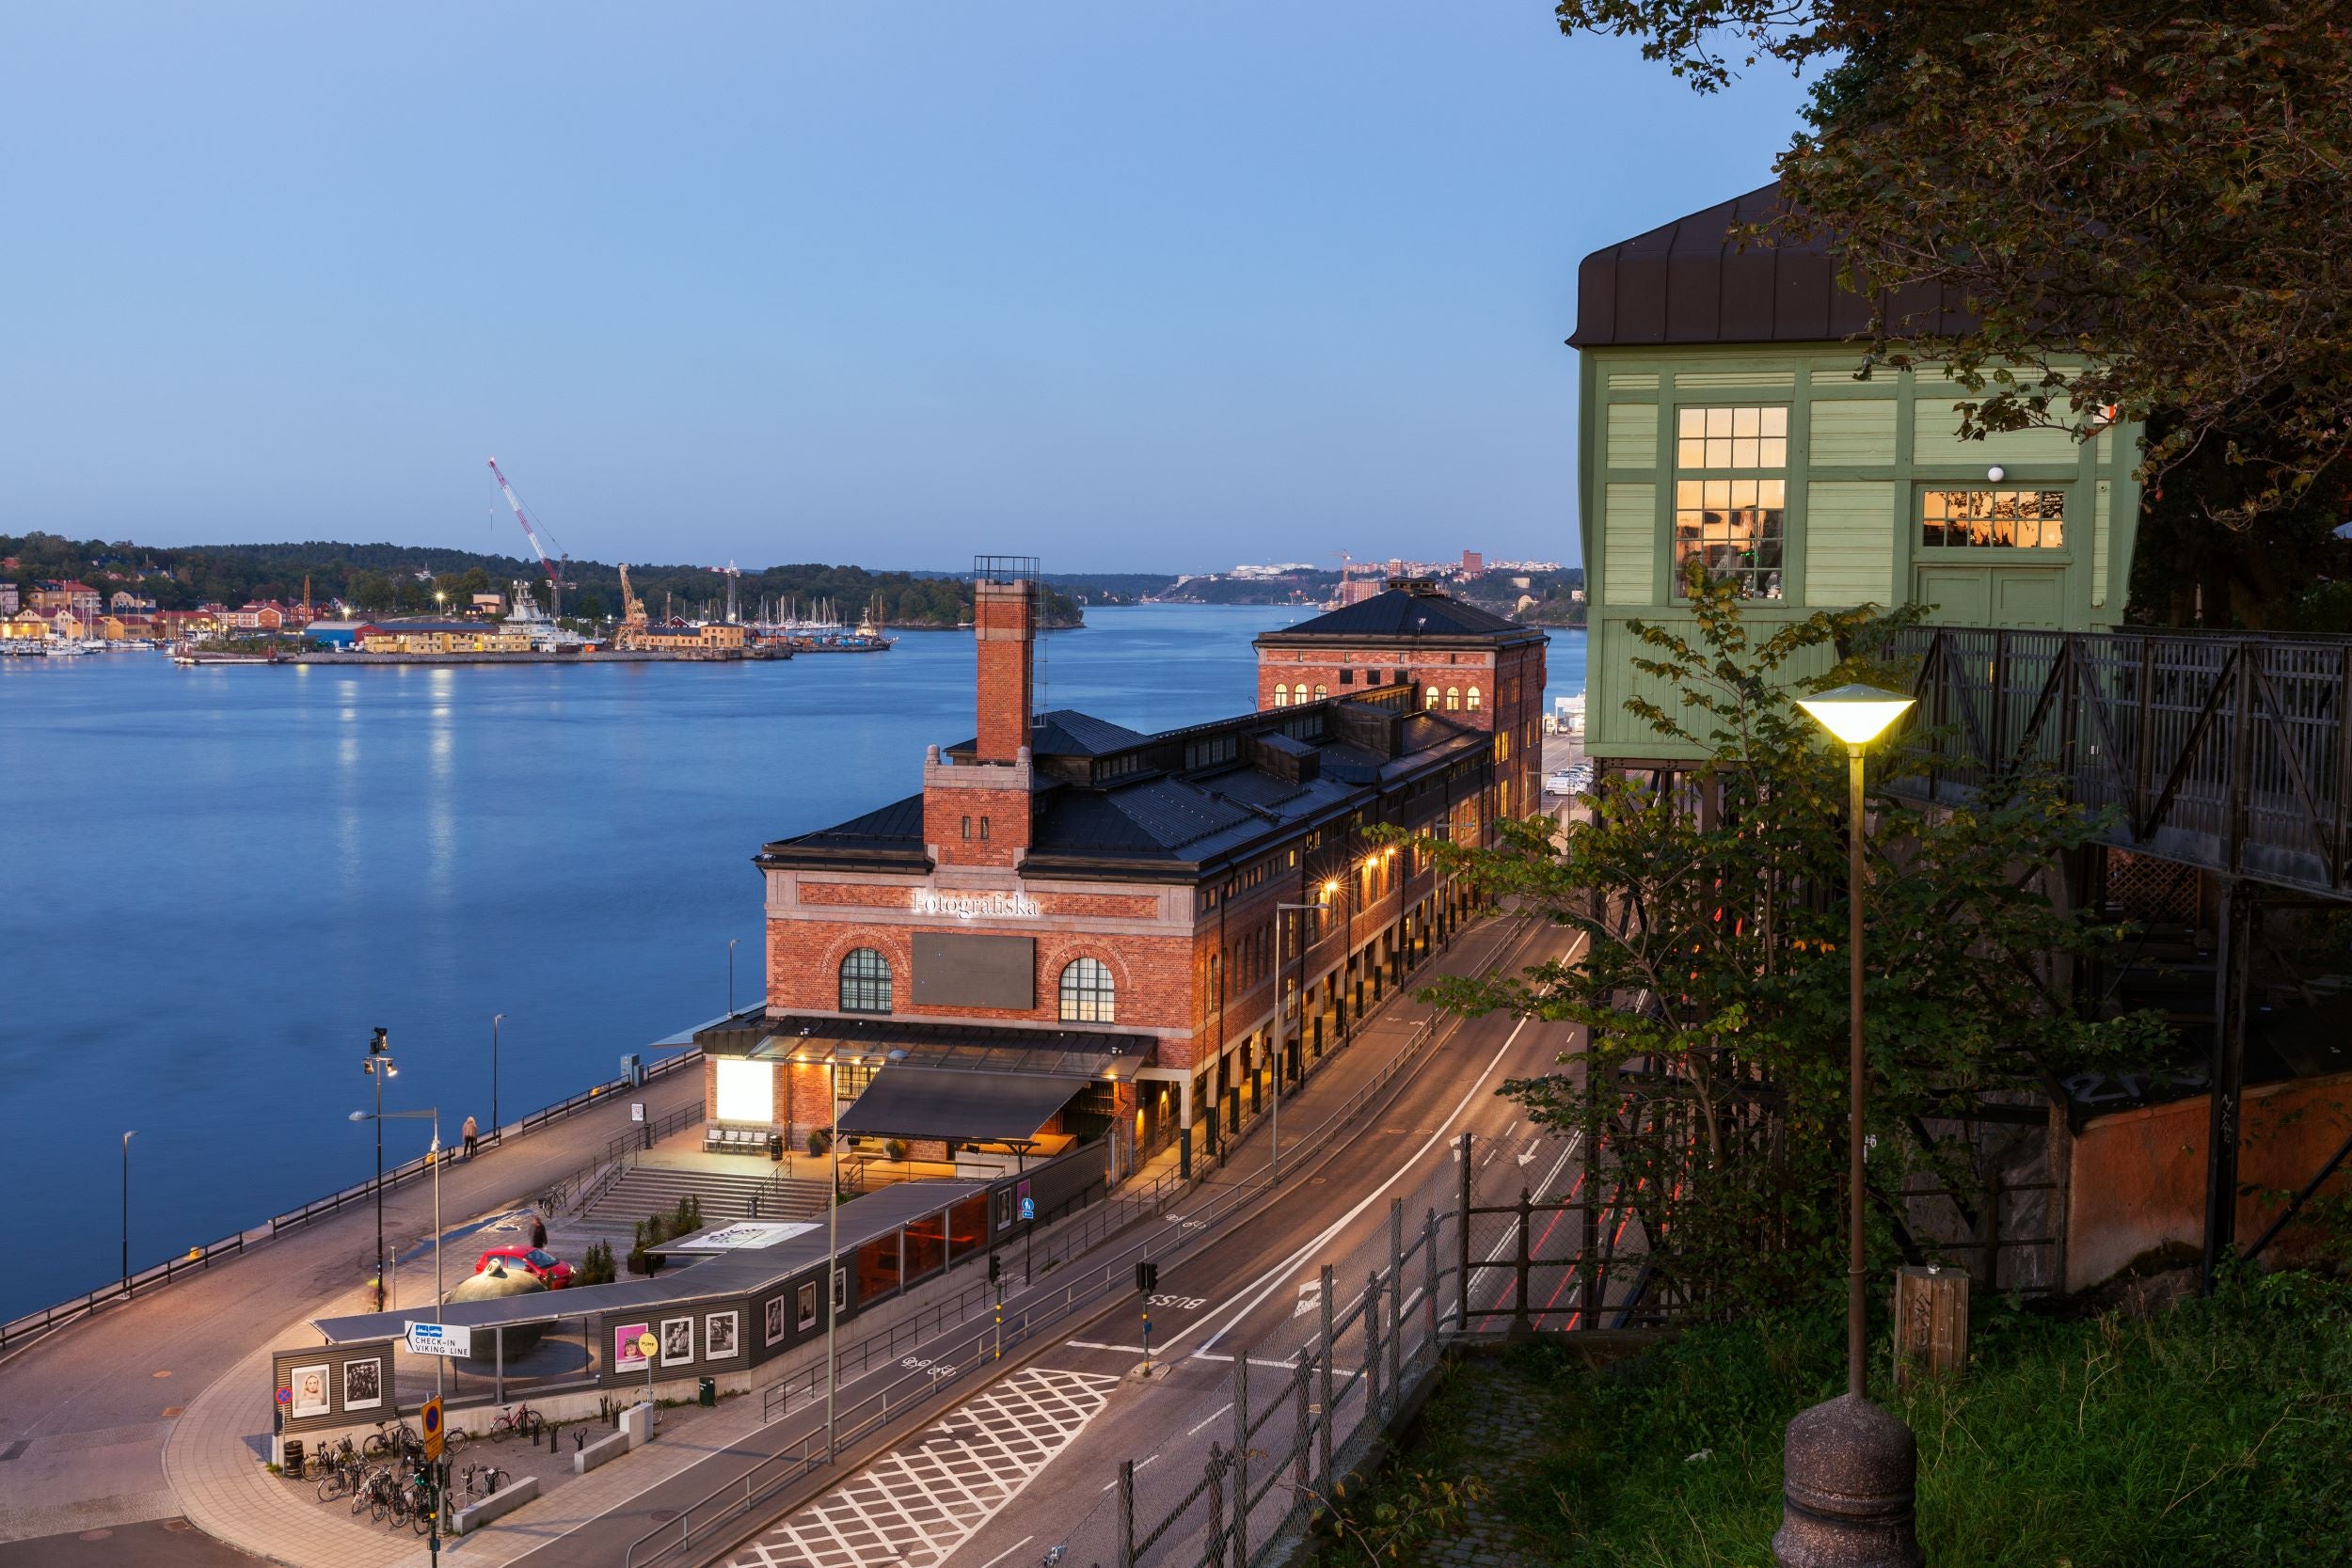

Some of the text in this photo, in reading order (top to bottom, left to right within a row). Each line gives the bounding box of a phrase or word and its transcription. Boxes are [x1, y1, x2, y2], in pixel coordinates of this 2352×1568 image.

[913, 891, 1038, 919] Fotografiska
[1146, 1294, 1207, 1309] BUSS
[415, 1337, 455, 1346] CHECK-IN
[415, 1345, 445, 1354] VIKING
